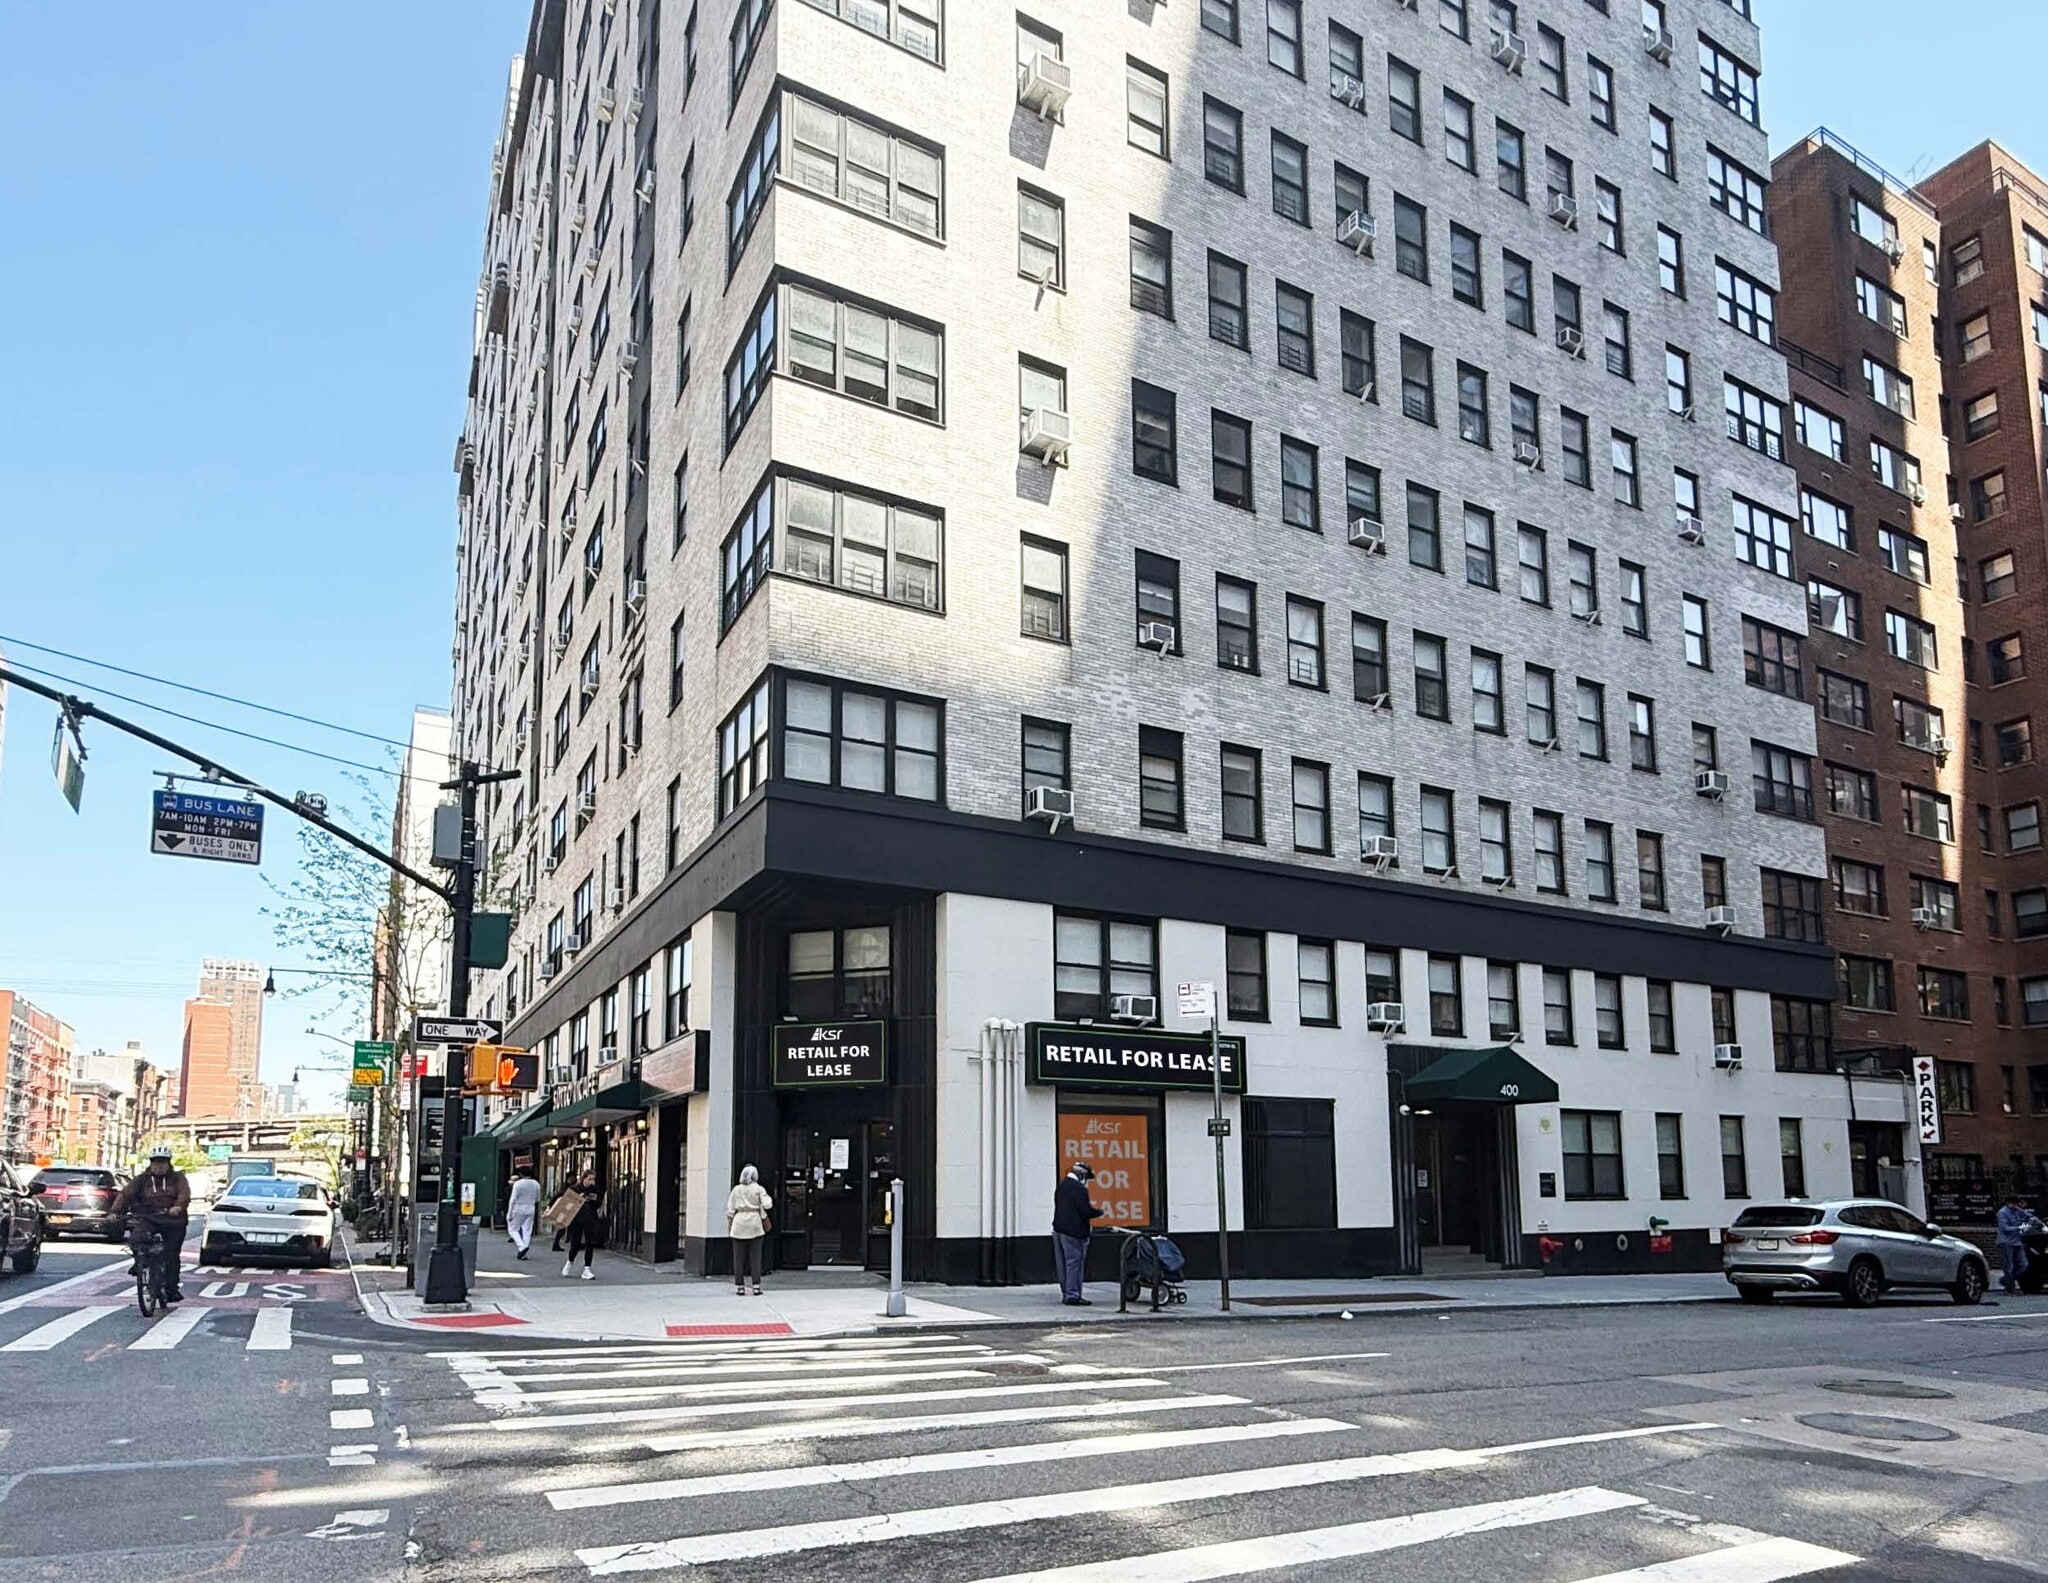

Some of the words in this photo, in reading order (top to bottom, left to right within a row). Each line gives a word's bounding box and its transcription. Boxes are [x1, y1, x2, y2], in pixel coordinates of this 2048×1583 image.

[184, 798, 212, 812] BUS
[217, 803, 256, 817] LANE
[159, 811, 207, 824] 7AM-10AM
[213, 817, 257, 831] 2PM-7PM
[184, 824, 205, 834] MON
[214, 827, 231, 837] FRI
[189, 836, 223, 848] BUSES
[229, 840, 256, 852] ONLY
[425, 1024, 449, 1036] ONE
[465, 1026, 488, 1037] WAY
[788, 1046, 837, 1059] RETAIL
[840, 1045, 870, 1058] FOR
[1046, 1044, 1117, 1065] RETAIL
[1121, 1050, 1163, 1068] FOR
[807, 1064, 852, 1077] LEASE
[1500, 1084, 1519, 1096] 400
[1920, 1073, 1935, 1127] PARK
[1065, 1139, 1145, 1159] RETAIL
